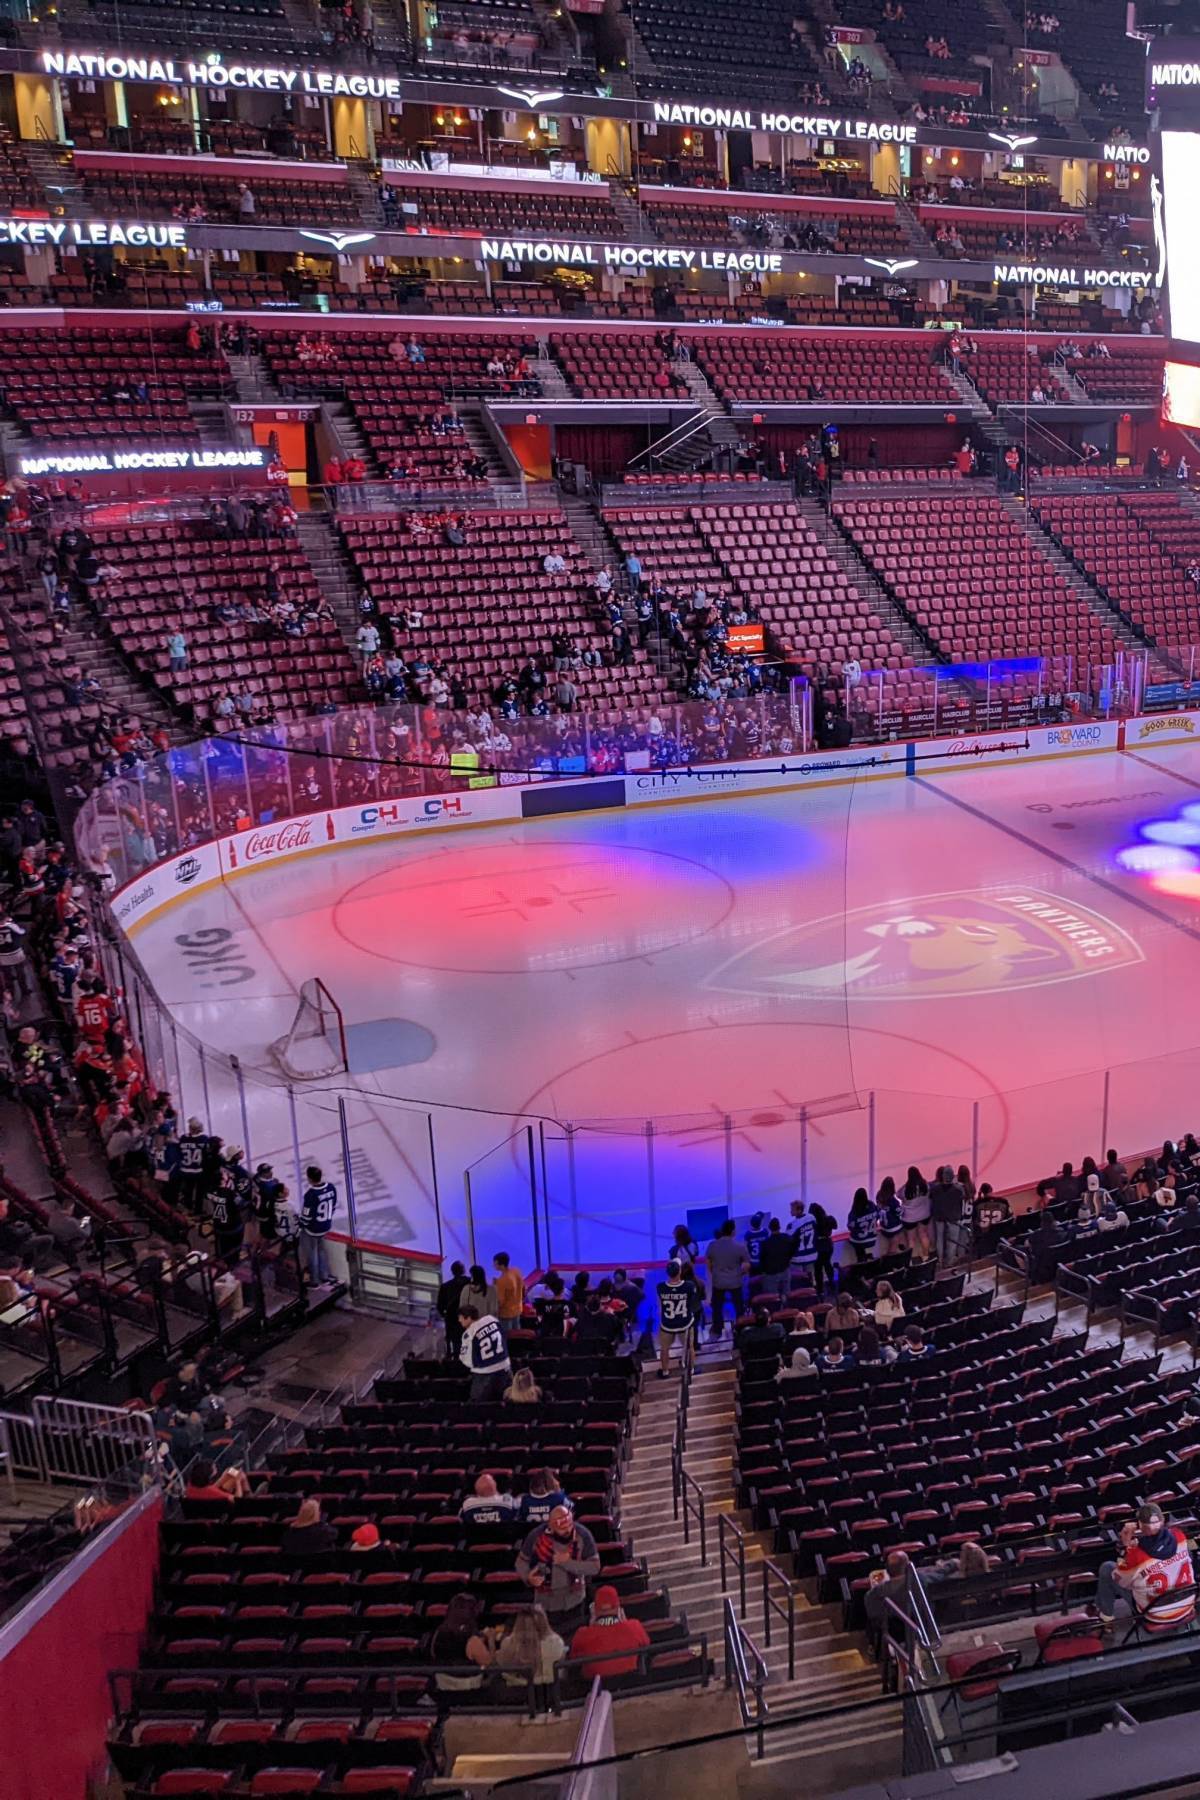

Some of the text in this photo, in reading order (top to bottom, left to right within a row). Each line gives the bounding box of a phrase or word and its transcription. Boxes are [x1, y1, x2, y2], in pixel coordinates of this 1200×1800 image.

[43, 53, 401, 99] NATIONAL HOCKEY LEAGUE
[654, 103, 917, 143] NATIONAL HOCKEY LEAGUE
[1103, 144, 1151, 163] NATIO
[75, 224, 187, 248] LEAGUE
[481, 240, 783, 273] NATIONAL HOCKEY LEAGUE
[994, 265, 1080, 285] NATIONAL
[1084, 270, 1152, 288] HOCKEY
[236, 410, 255, 422] 132
[115, 452, 190, 469] HOCKEY
[192, 450, 264, 467] LEAGUE
[873, 717, 903, 726] HAIRCLUB
[942, 709, 970, 719] HAIRCLUB
[1144, 717, 1189, 732] GOOD GREEK
[1072, 738, 1101, 748] COUNTY
[361, 805, 399, 824] CH
[424, 797, 462, 815] CH
[245, 818, 312, 861] Coca-Cola
[175, 861, 202, 880] NHL
[131, 884, 155, 910] Health
[996, 895, 1114, 957] PANTHERS
[84, 1009, 102, 1025] 16
[181, 1149, 203, 1166] 34
[316, 1199, 333, 1222] 91
[980, 1210, 1002, 1228] 52
[858, 1219, 877, 1238] 34
[751, 1241, 760, 1257] 3
[661, 1293, 688, 1301] MATTHEWS
[663, 1300, 688, 1319] 34
[479, 1335, 504, 1360] 27
